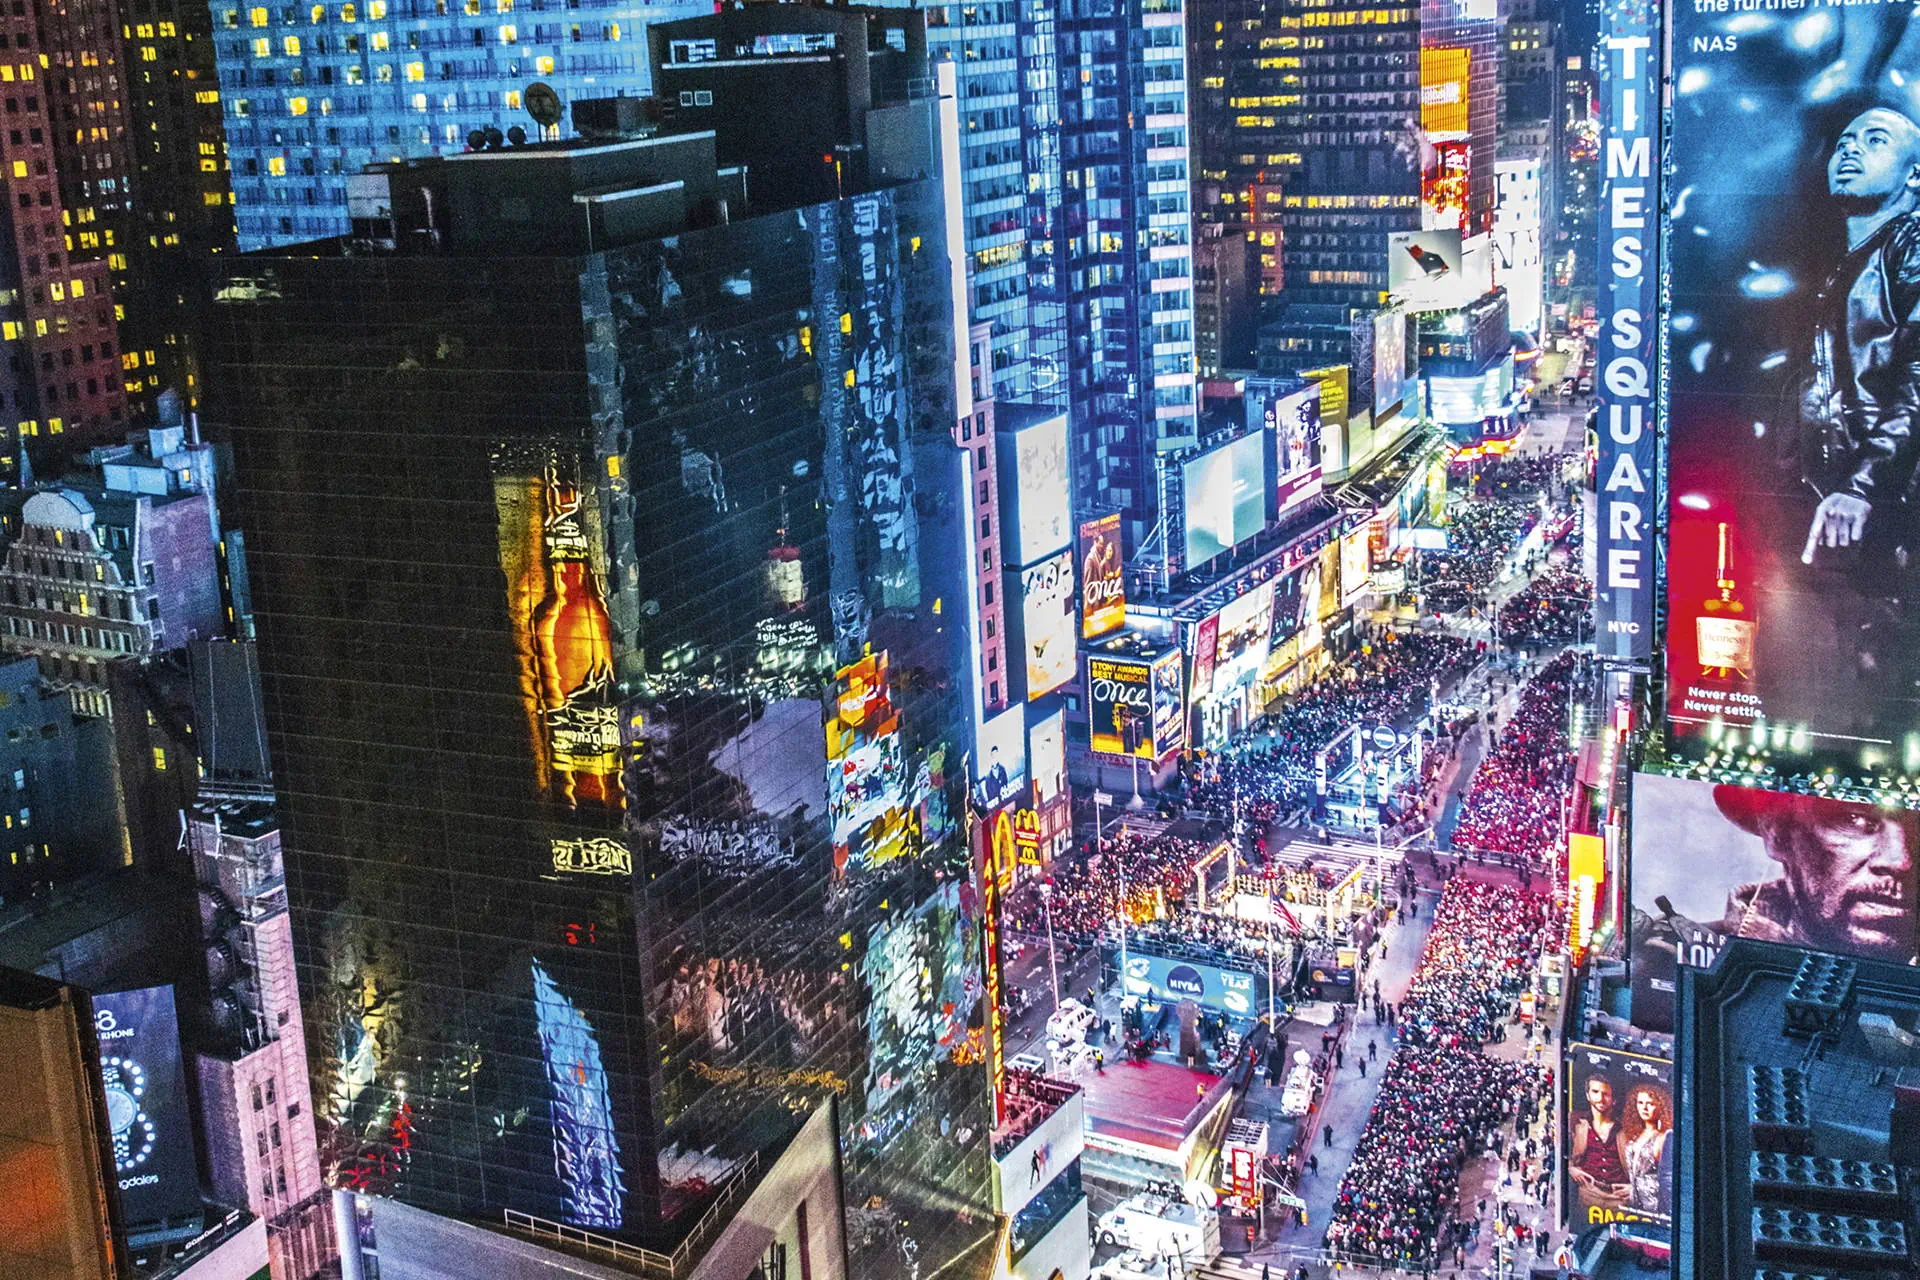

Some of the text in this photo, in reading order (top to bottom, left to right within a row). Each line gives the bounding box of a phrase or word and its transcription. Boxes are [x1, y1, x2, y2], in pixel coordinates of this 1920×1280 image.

[1694, 0, 1729, 13] the
[1693, 36, 1737, 53] NAS
[1604, 36, 1651, 589] TIMES SQUARE
[1607, 620, 1640, 634] NYC
[1092, 670, 1112, 679] BEST
[1688, 686, 1762, 706] Never stop.
[1684, 699, 1766, 719] Never settle.
[1169, 979, 1201, 993] NIVEA
[101, 1028, 135, 1040] RHONE
[118, 1174, 159, 1190] gdales
